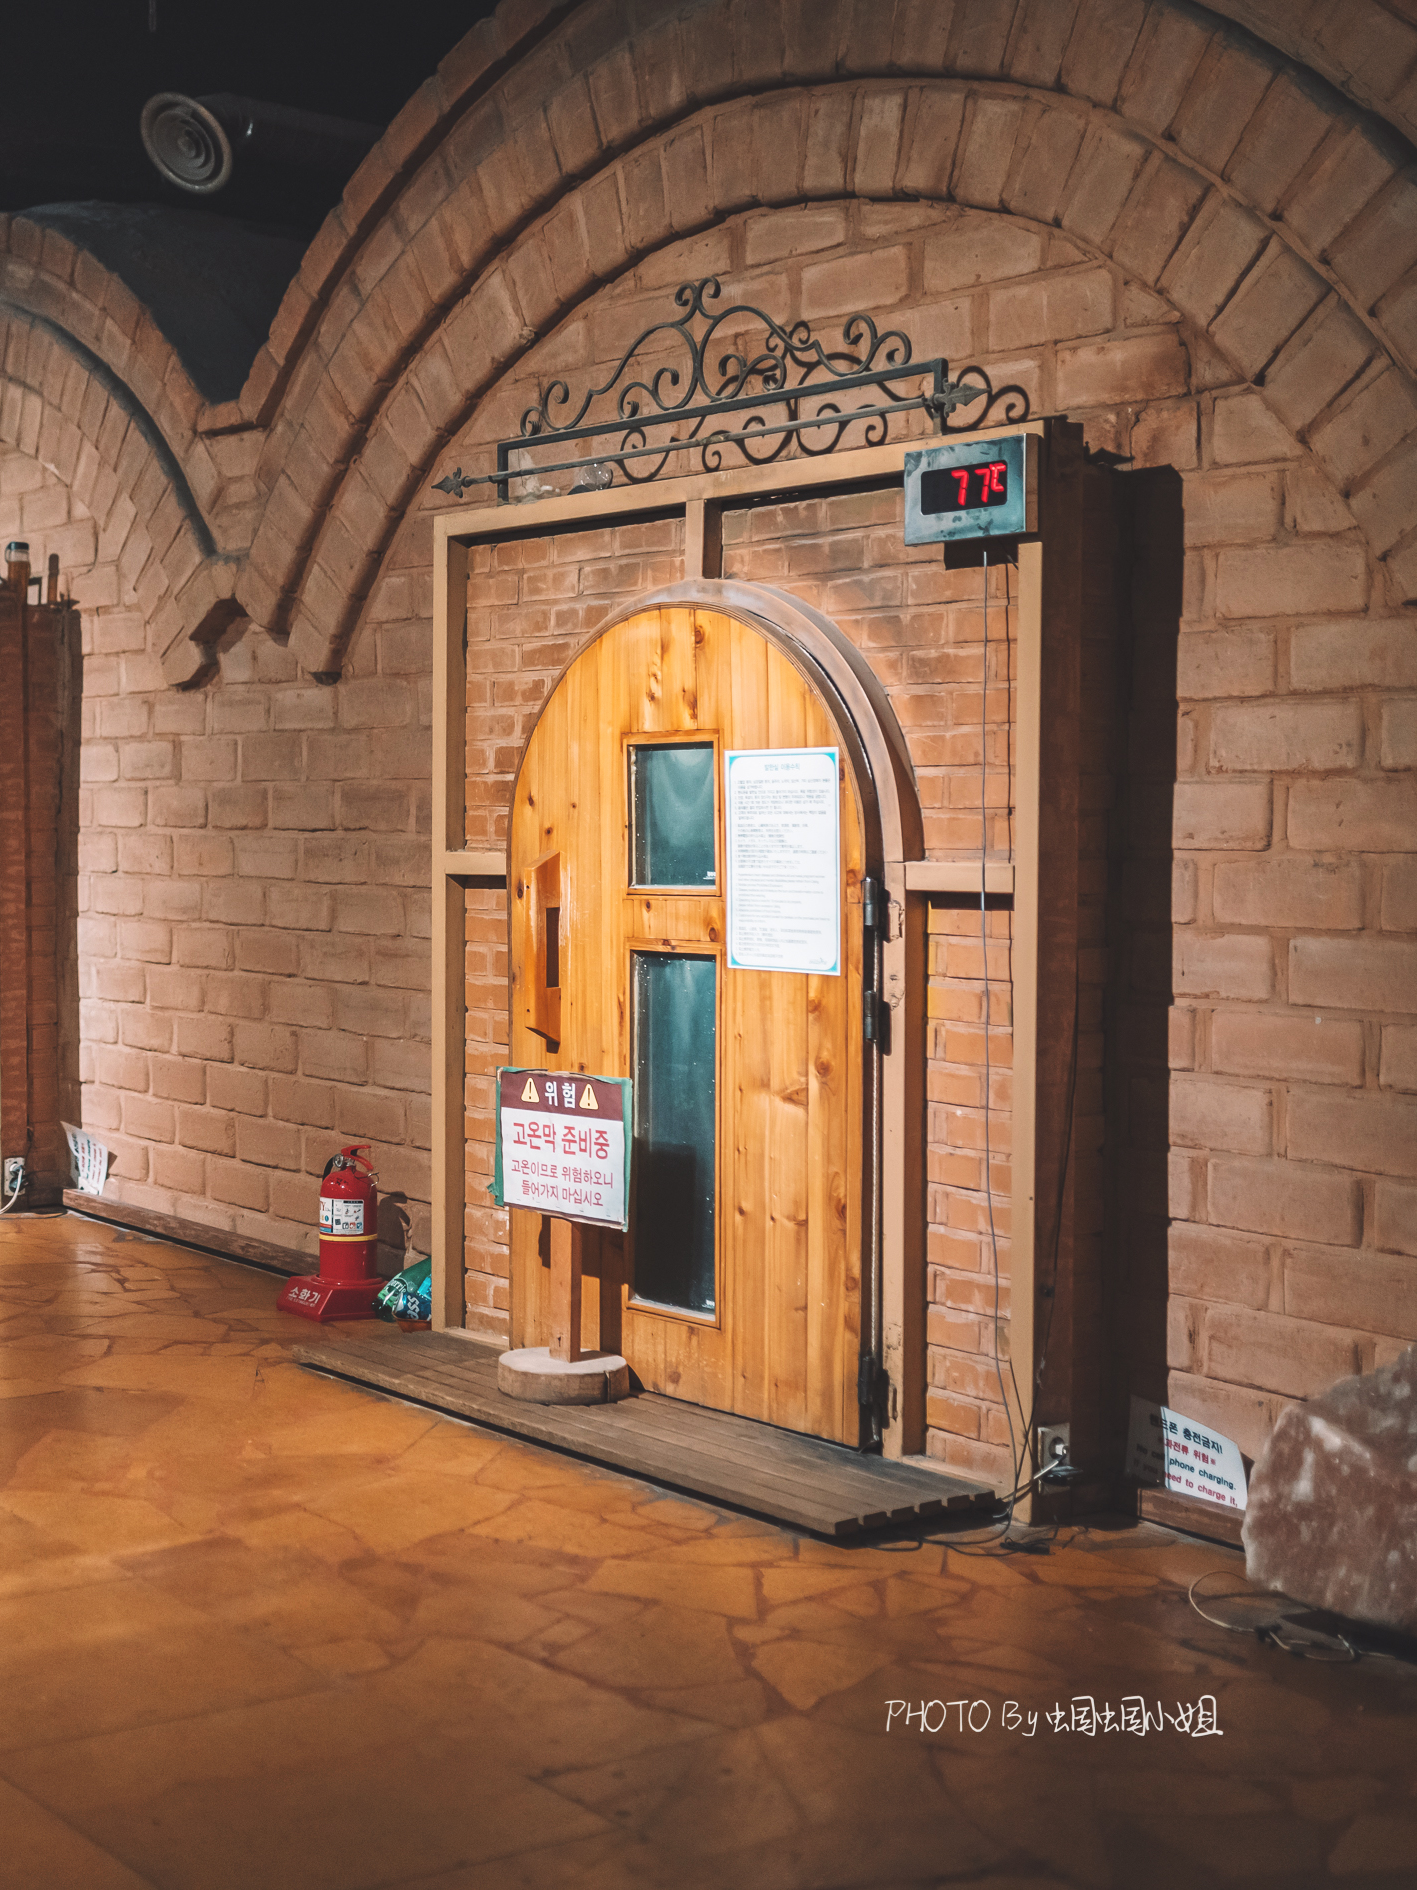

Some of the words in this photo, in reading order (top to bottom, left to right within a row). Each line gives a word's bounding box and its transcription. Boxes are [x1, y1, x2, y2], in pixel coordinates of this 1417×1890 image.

[512, 1121, 557, 1154] 고온막
[561, 1125, 611, 1160] 준비중
[511, 1159, 559, 1179] 고온이므로
[561, 1166, 614, 1189] 위험하오니
[521, 1179, 559, 1200] 들어가지
[561, 1187, 604, 1207] 마십시오
[287, 1286, 321, 1304] 소화기
[1169, 1457, 1196, 1474] phone
[1198, 1469, 1236, 1491] charging.
[1185, 1478, 1195, 1490] to
[1197, 1484, 1227, 1502] charge
